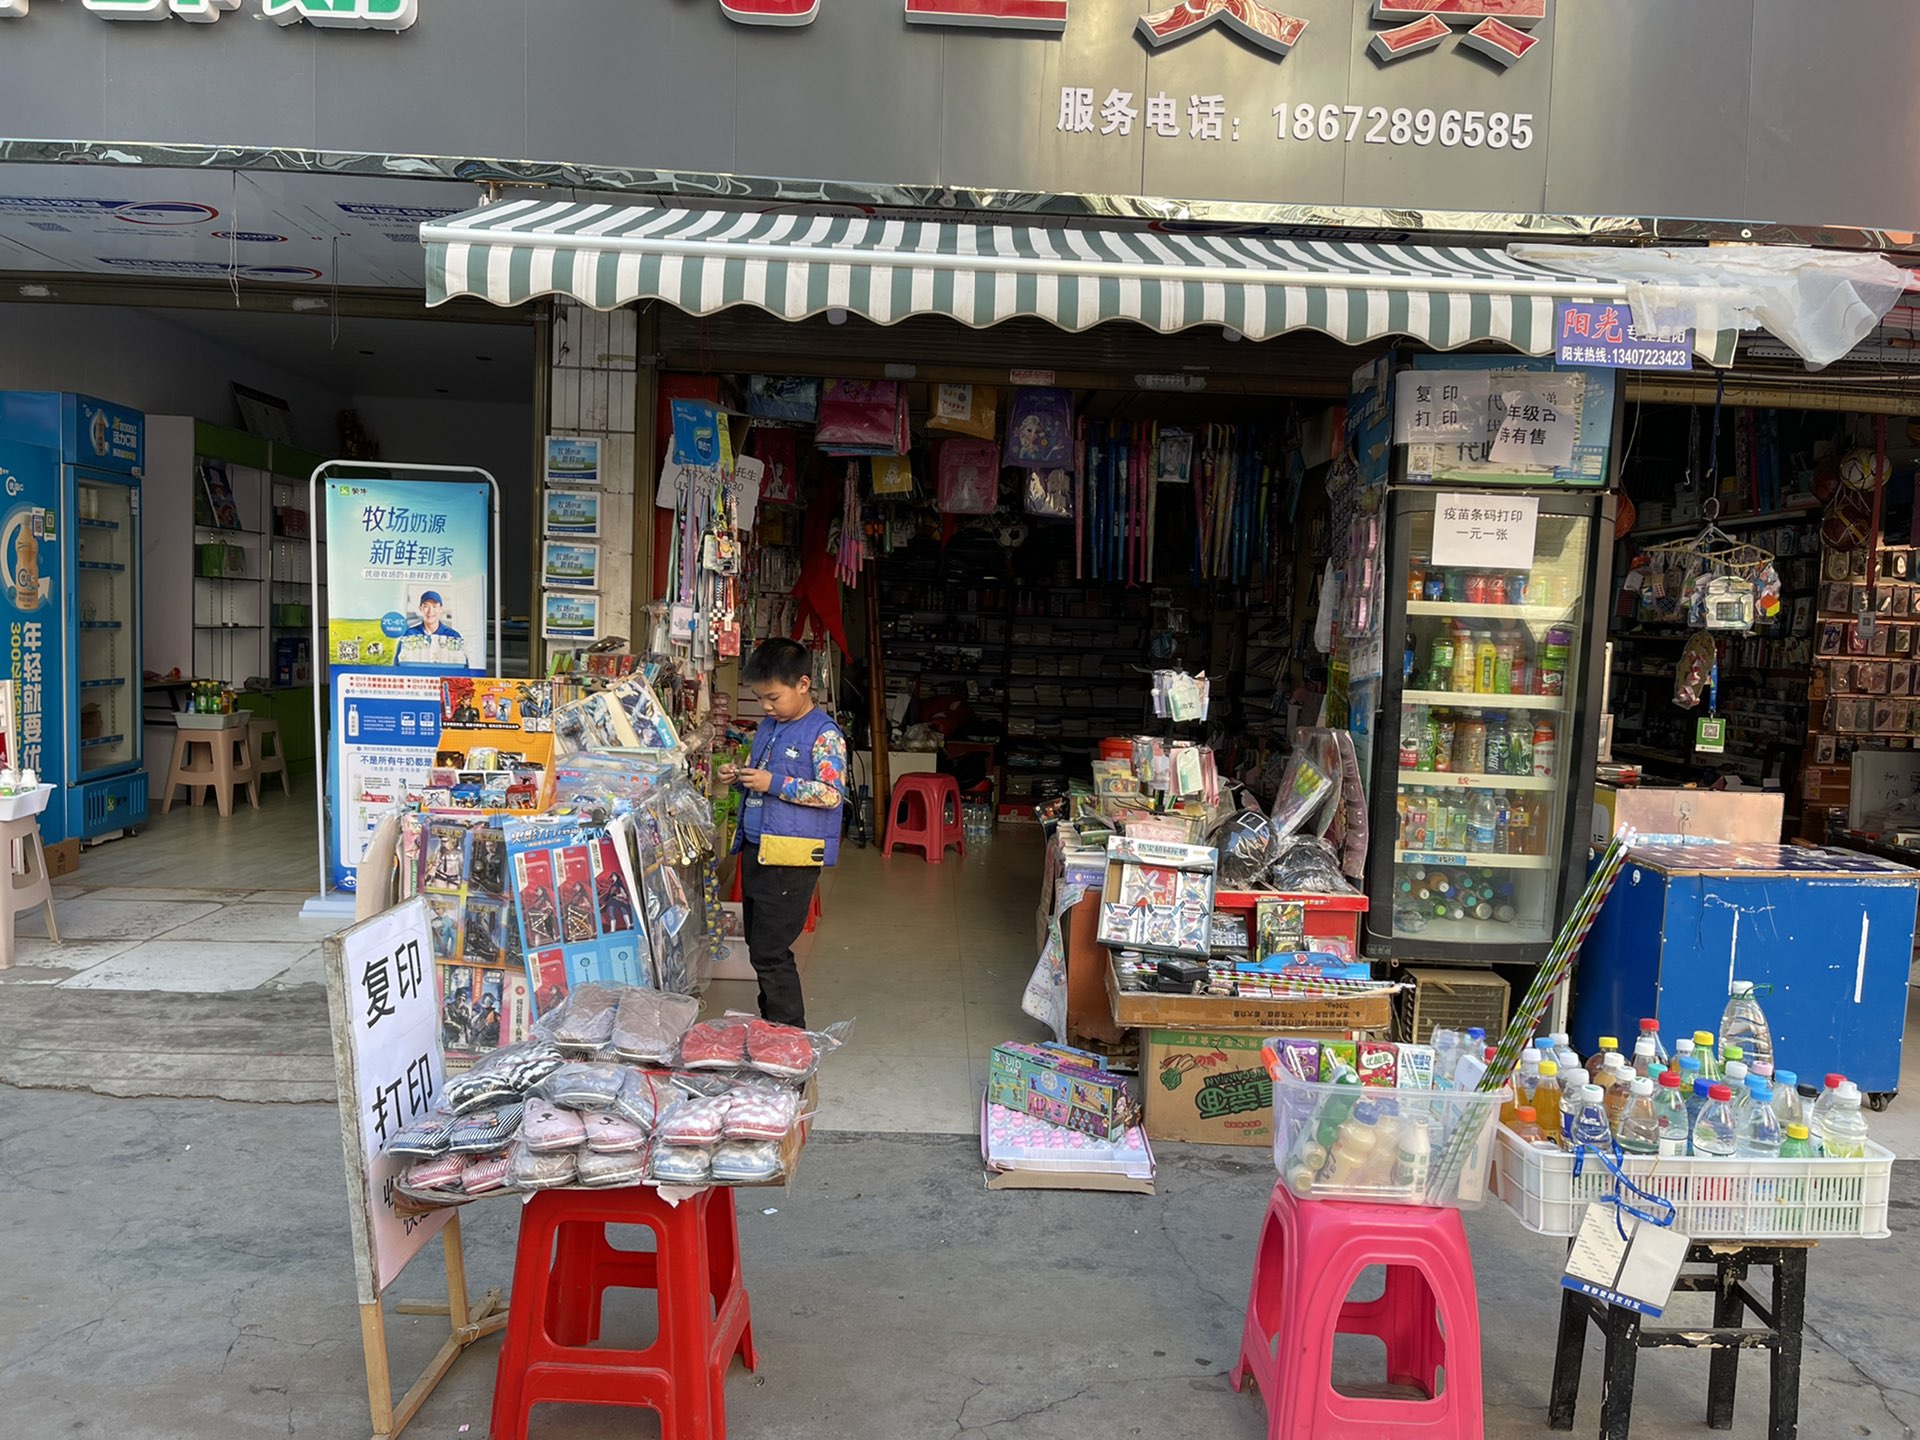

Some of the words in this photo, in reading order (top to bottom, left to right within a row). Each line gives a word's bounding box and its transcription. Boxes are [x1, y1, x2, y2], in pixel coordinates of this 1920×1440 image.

[1272, 103, 1534, 150] 18672896585
[1563, 307, 1623, 343] 阳光
[362, 505, 447, 534] 牧场奶源
[1444, 507, 1523, 524] 疫苗条码打印
[1456, 527, 1509, 541] 一元一张
[369, 539, 454, 567] 新鲜到家
[360, 755, 433, 767] 不是所有牛奶都是
[362, 938, 422, 1029] 复印
[994, 1051, 1022, 1069] SQUID
[372, 1053, 434, 1151] 打印
